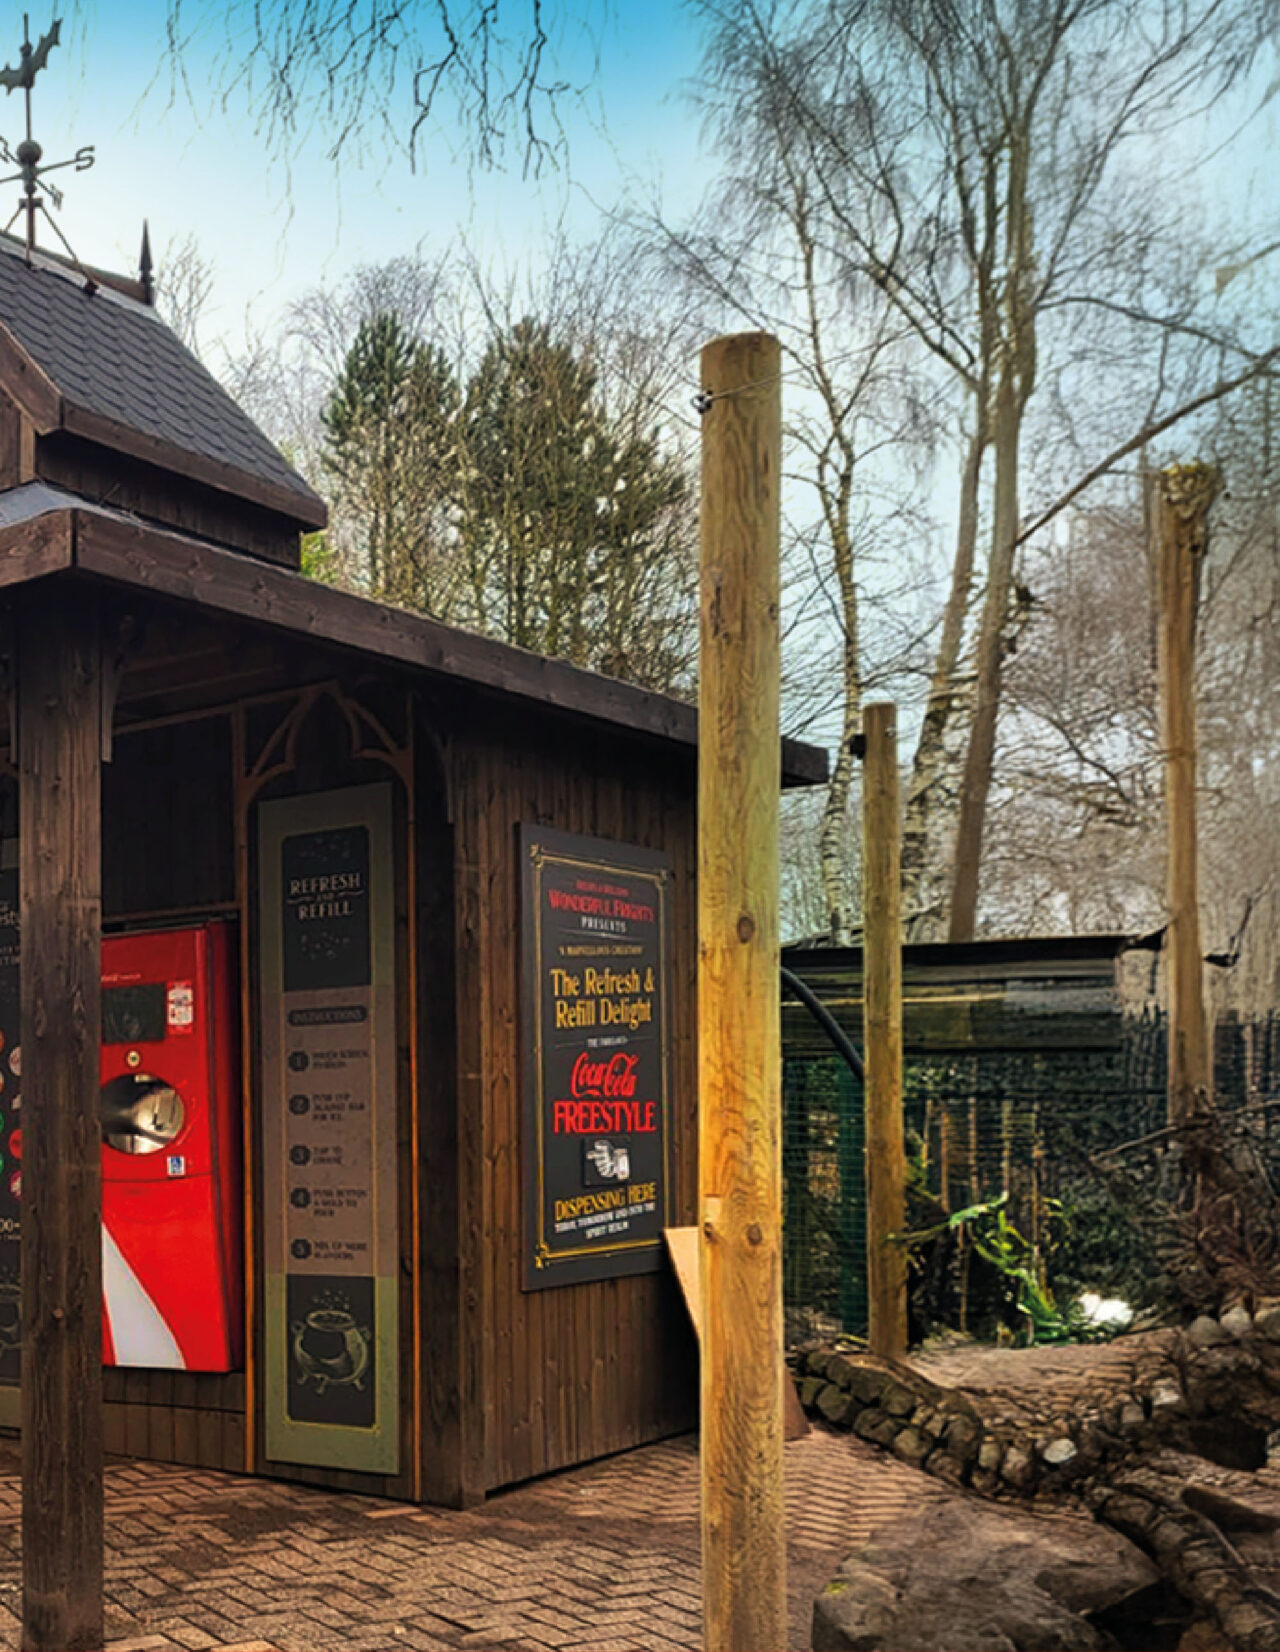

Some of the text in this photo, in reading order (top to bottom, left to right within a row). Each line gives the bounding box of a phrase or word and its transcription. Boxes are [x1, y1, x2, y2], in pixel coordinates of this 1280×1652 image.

[290, 873, 361, 896] REFRESH
[298, 901, 354, 920] REFILL
[581, 915, 627, 933] PRESENTS
[549, 967, 655, 997] The Refresh &
[556, 997, 651, 1030] Refill Delight
[553, 1100, 657, 1134] FREESTYLE
[554, 1188, 626, 1221] DISPENSING
[628, 1181, 657, 1204] HERE
